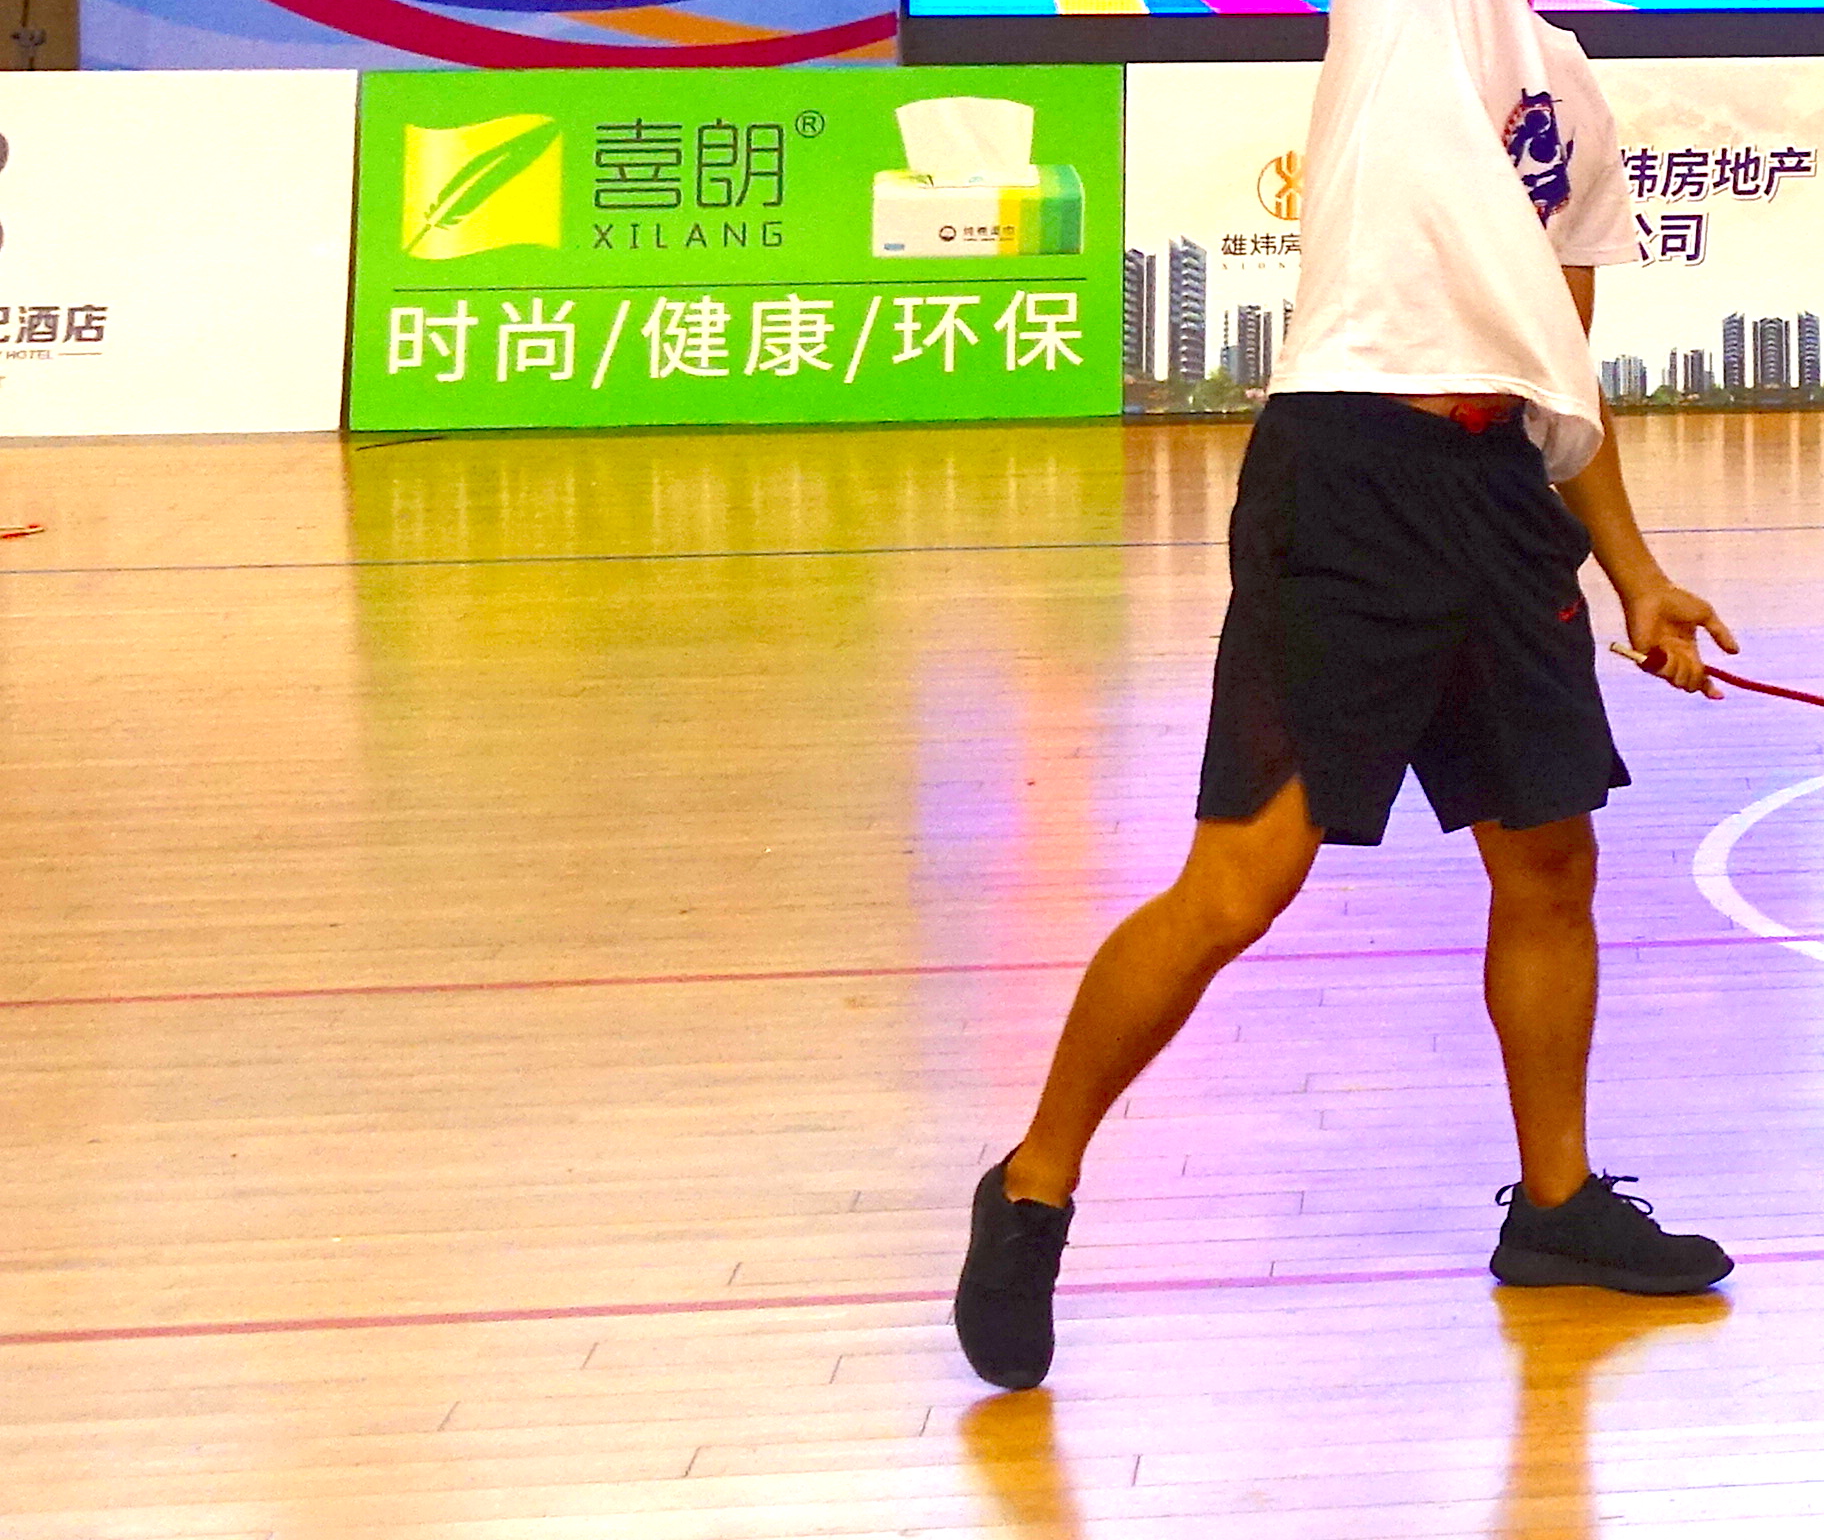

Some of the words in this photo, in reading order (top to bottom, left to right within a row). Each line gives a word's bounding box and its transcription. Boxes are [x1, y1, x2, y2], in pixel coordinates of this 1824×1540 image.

[593, 117, 785, 210] 喜朗
[593, 221, 785, 251] XILANG
[6, 349, 53, 360] HOTEL
[387, 290, 1085, 390] 时尚/健康/环保
